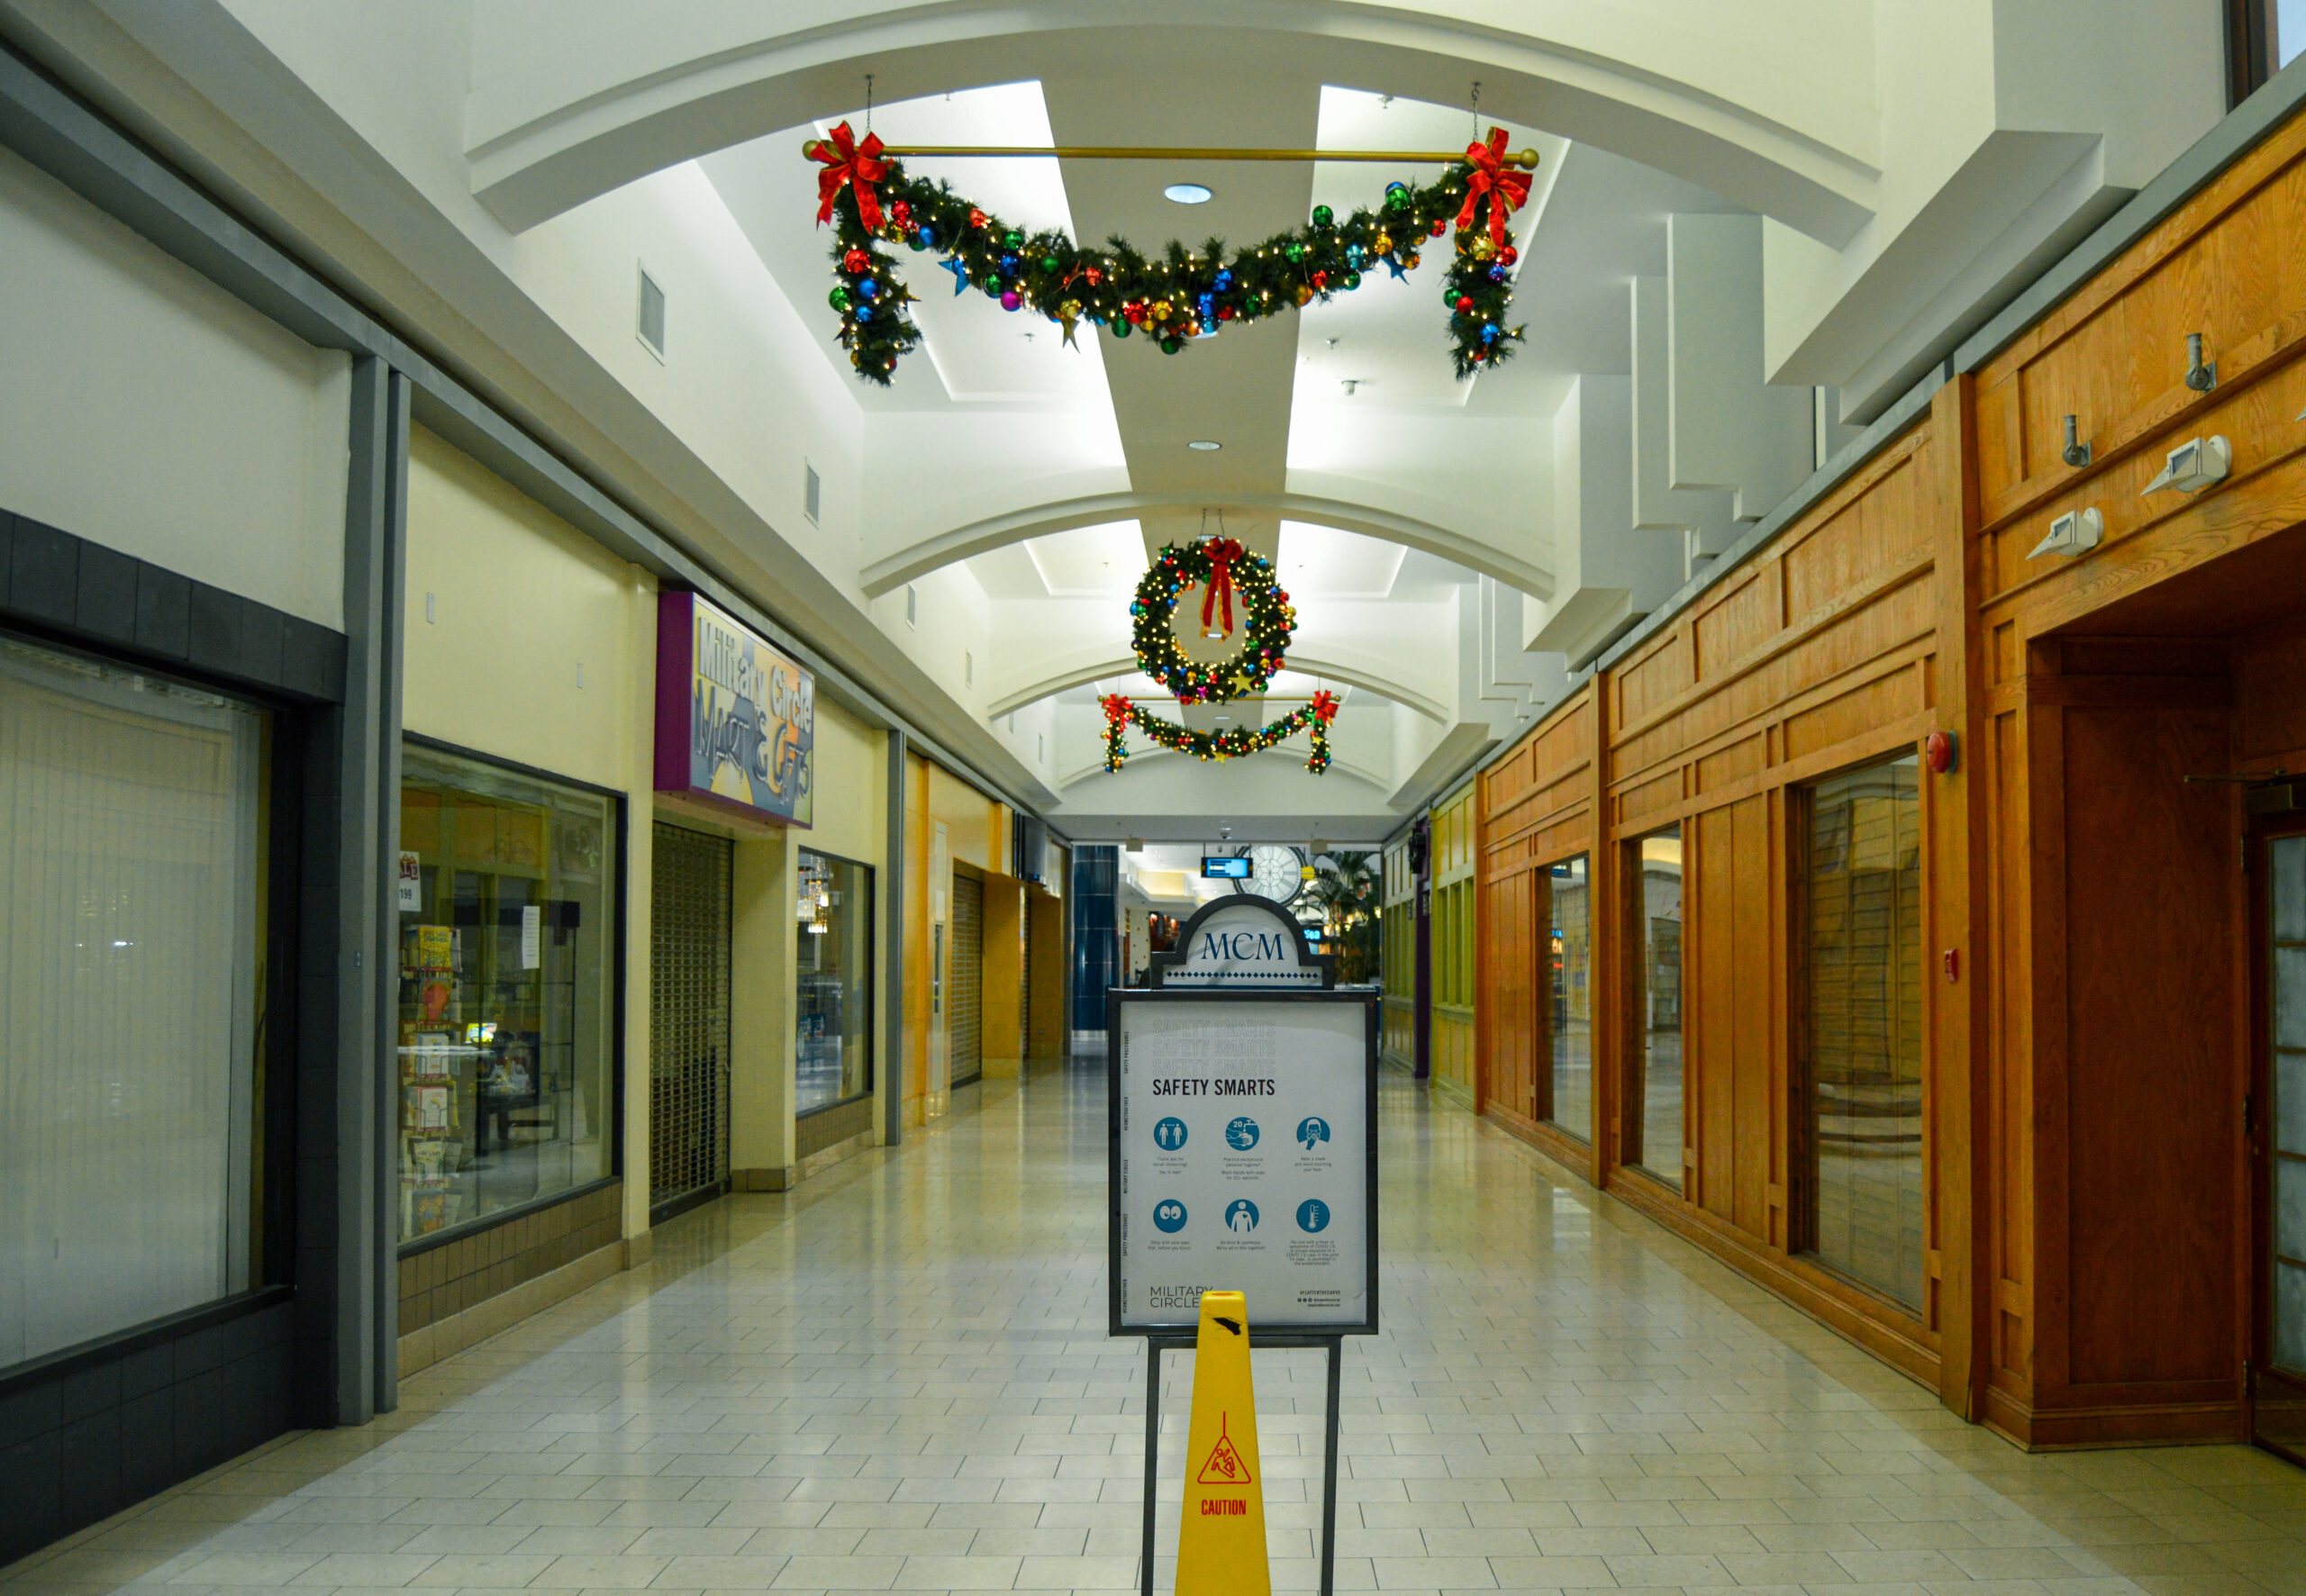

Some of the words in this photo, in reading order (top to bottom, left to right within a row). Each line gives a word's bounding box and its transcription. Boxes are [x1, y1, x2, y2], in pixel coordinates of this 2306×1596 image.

[699, 617, 766, 712] Military
[771, 666, 812, 733] Circle
[694, 678, 749, 783] MART
[1202, 933, 1285, 960] MCM
[1152, 1079, 1209, 1096] SAFETY
[1214, 1079, 1276, 1096] SMARTS
[1150, 1286, 1213, 1296] MILITARY
[1149, 1297, 1200, 1308] CIRCLE
[1202, 1499, 1247, 1516] CAUTION
